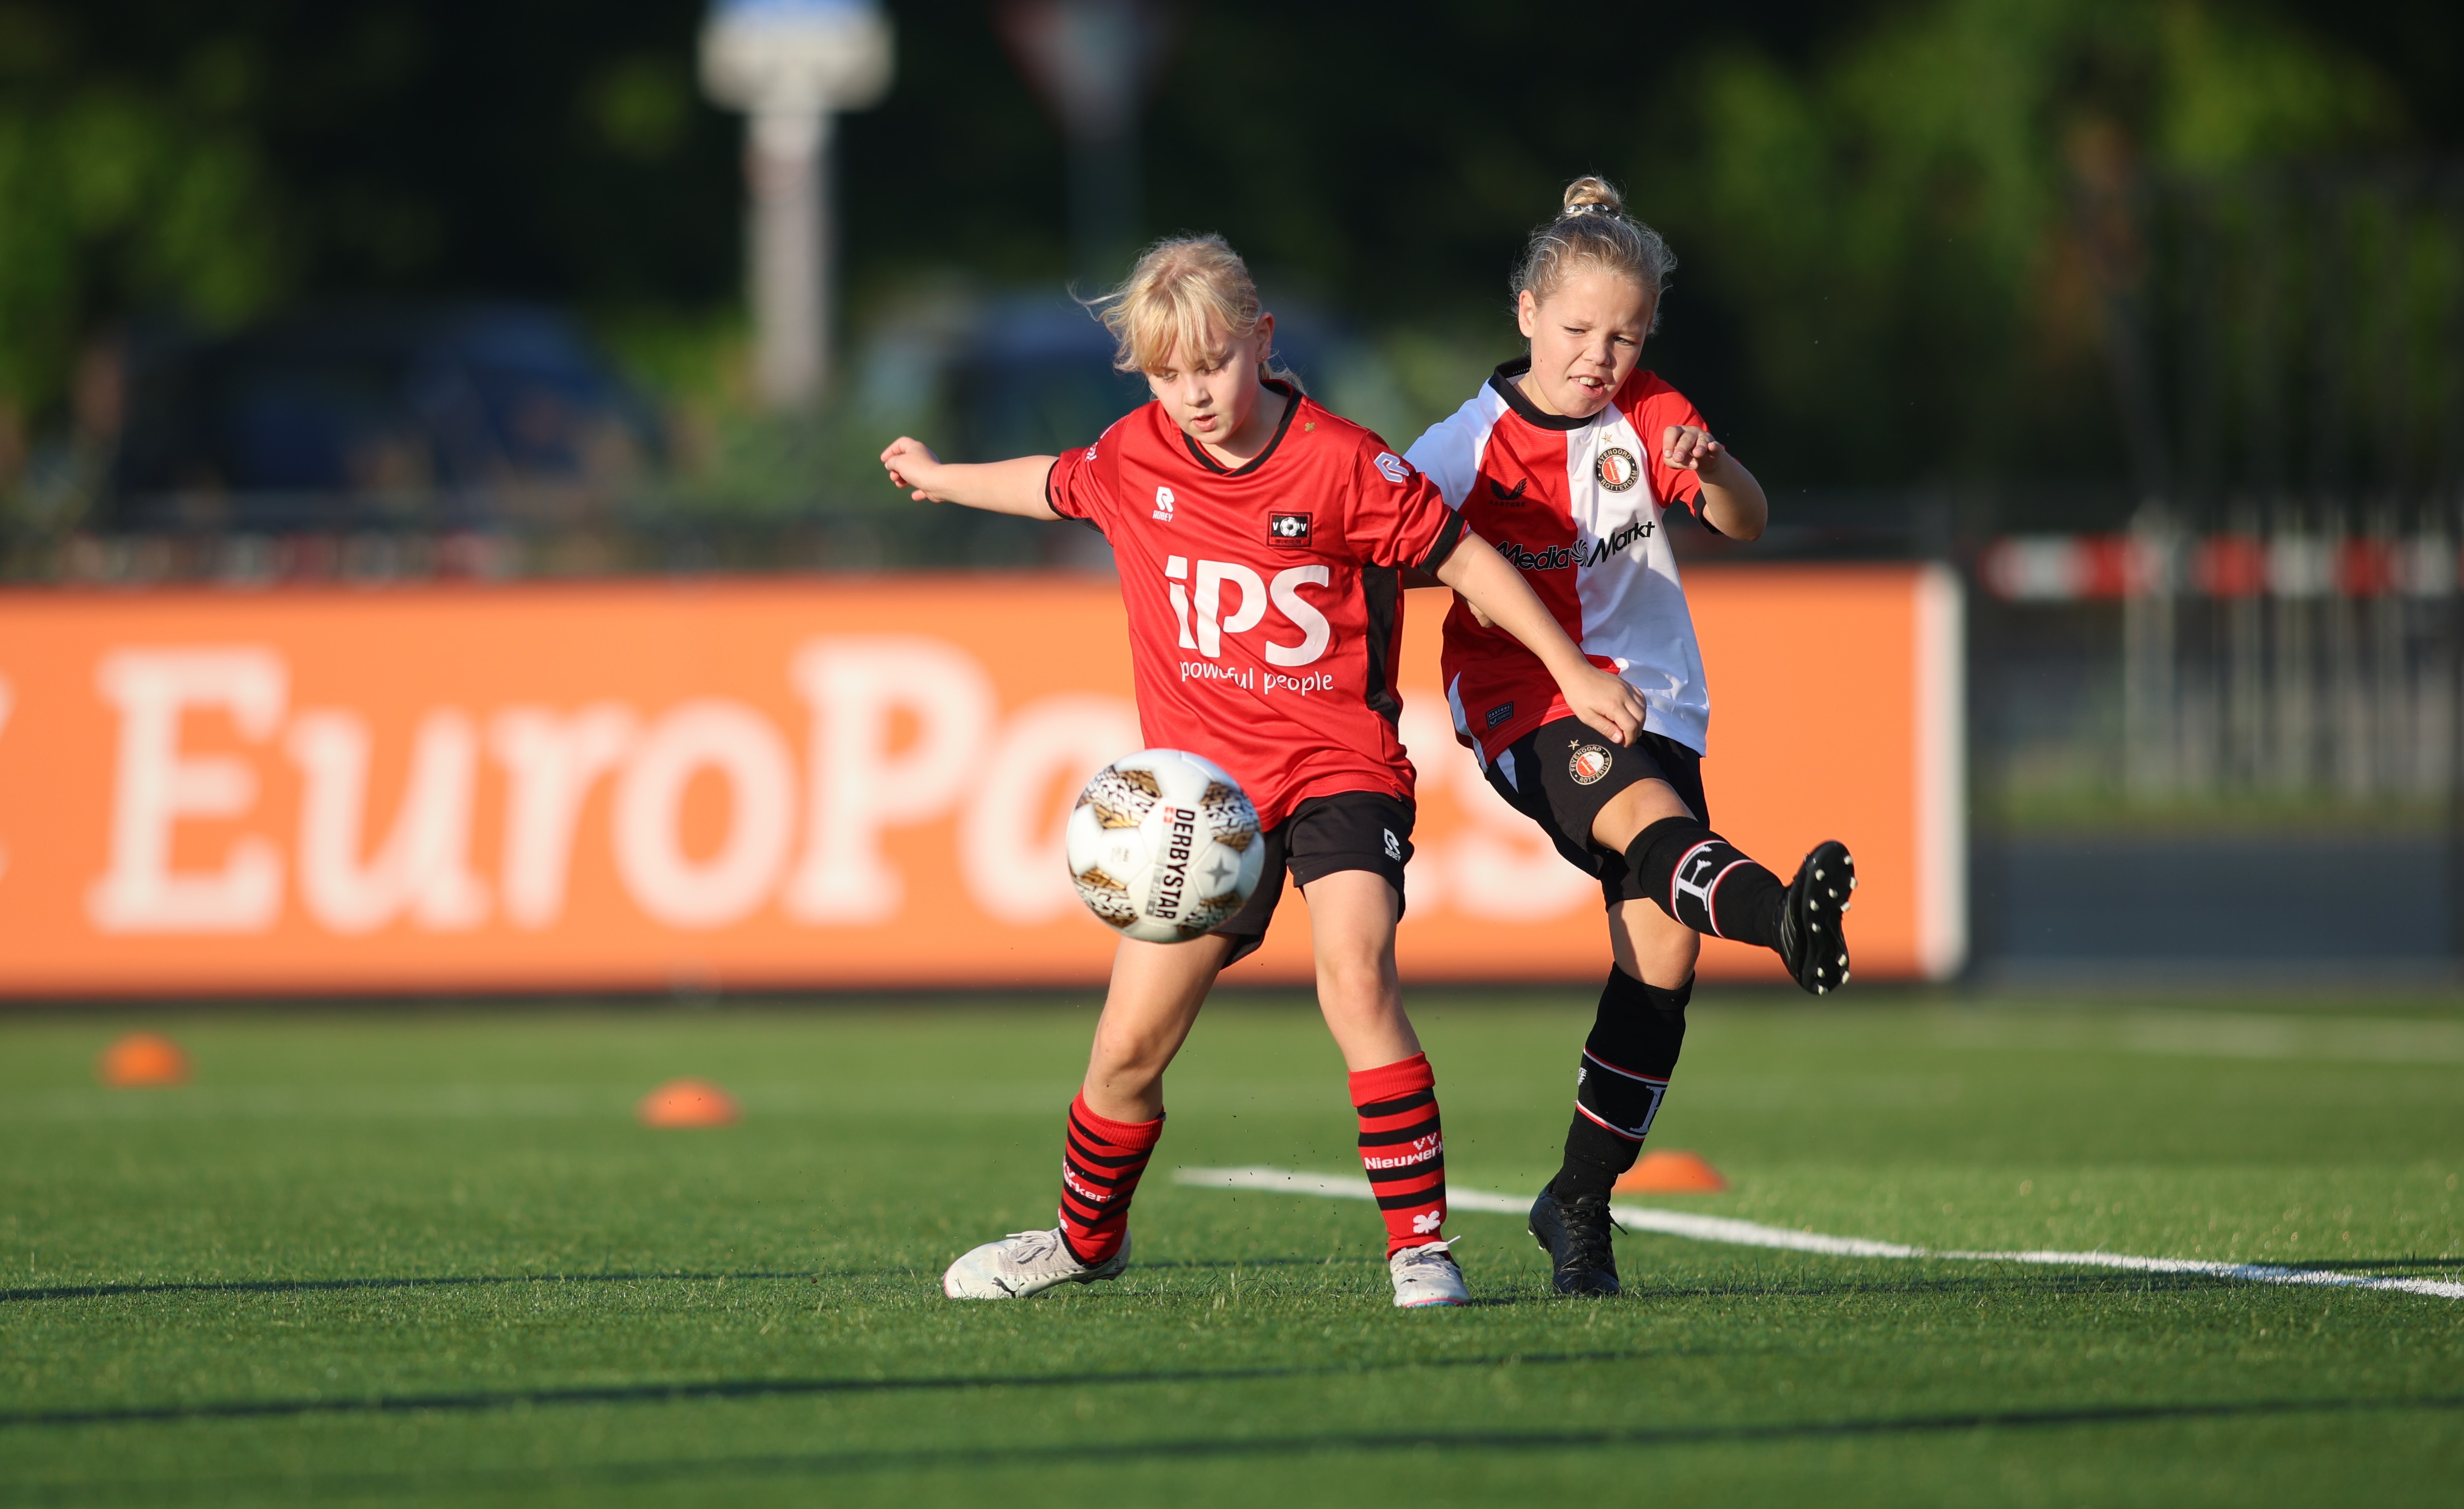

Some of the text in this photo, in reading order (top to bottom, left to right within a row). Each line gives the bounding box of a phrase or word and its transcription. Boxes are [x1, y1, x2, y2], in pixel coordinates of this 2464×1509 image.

[1597, 449, 1631, 468] FEYENOORD
[1600, 470, 1637, 491] ROTTERDAM
[1152, 510, 1173, 522] ROBEY
[1496, 521, 1655, 571] Media Markt
[1264, 671, 1334, 696] people
[1571, 746, 1602, 772] FEYENOORD
[1579, 757, 1610, 783] ROTTERDAM
[1156, 809, 1195, 919] DERBYSTAR
